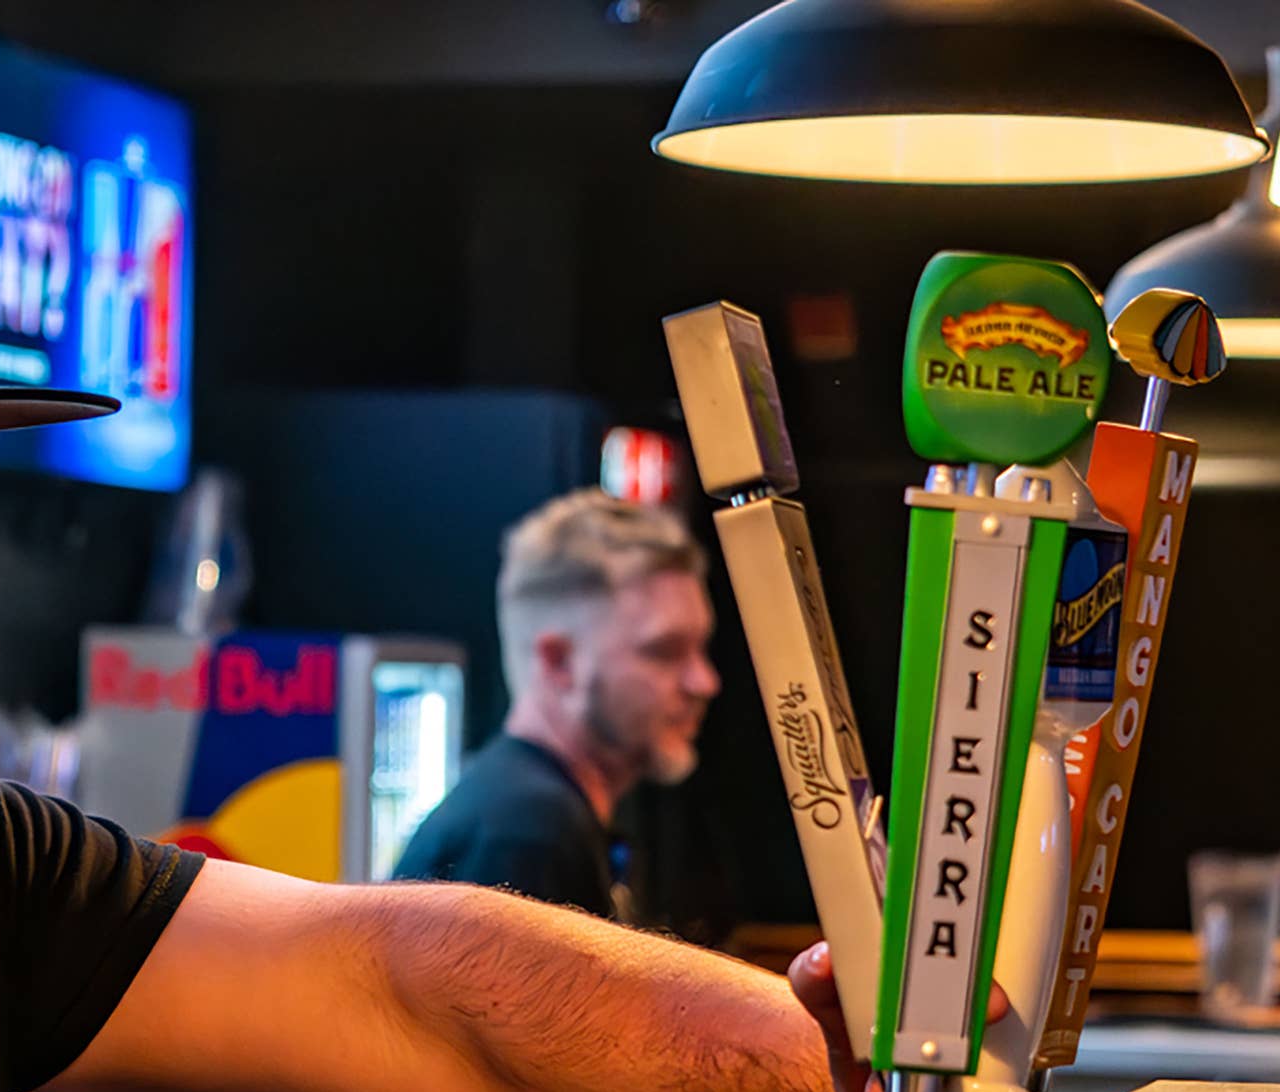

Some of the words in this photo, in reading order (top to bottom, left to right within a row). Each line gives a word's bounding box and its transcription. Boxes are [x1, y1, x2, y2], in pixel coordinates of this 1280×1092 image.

[926, 358, 1016, 394] PALE
[1027, 370, 1096, 400] ALE
[89, 644, 209, 712] Red
[219, 645, 336, 716] Bull
[1113, 450, 1192, 748] MANGO
[777, 680, 847, 830] Squatters
[924, 609, 995, 958] SIERRA
[1066, 783, 1123, 1017] CART
